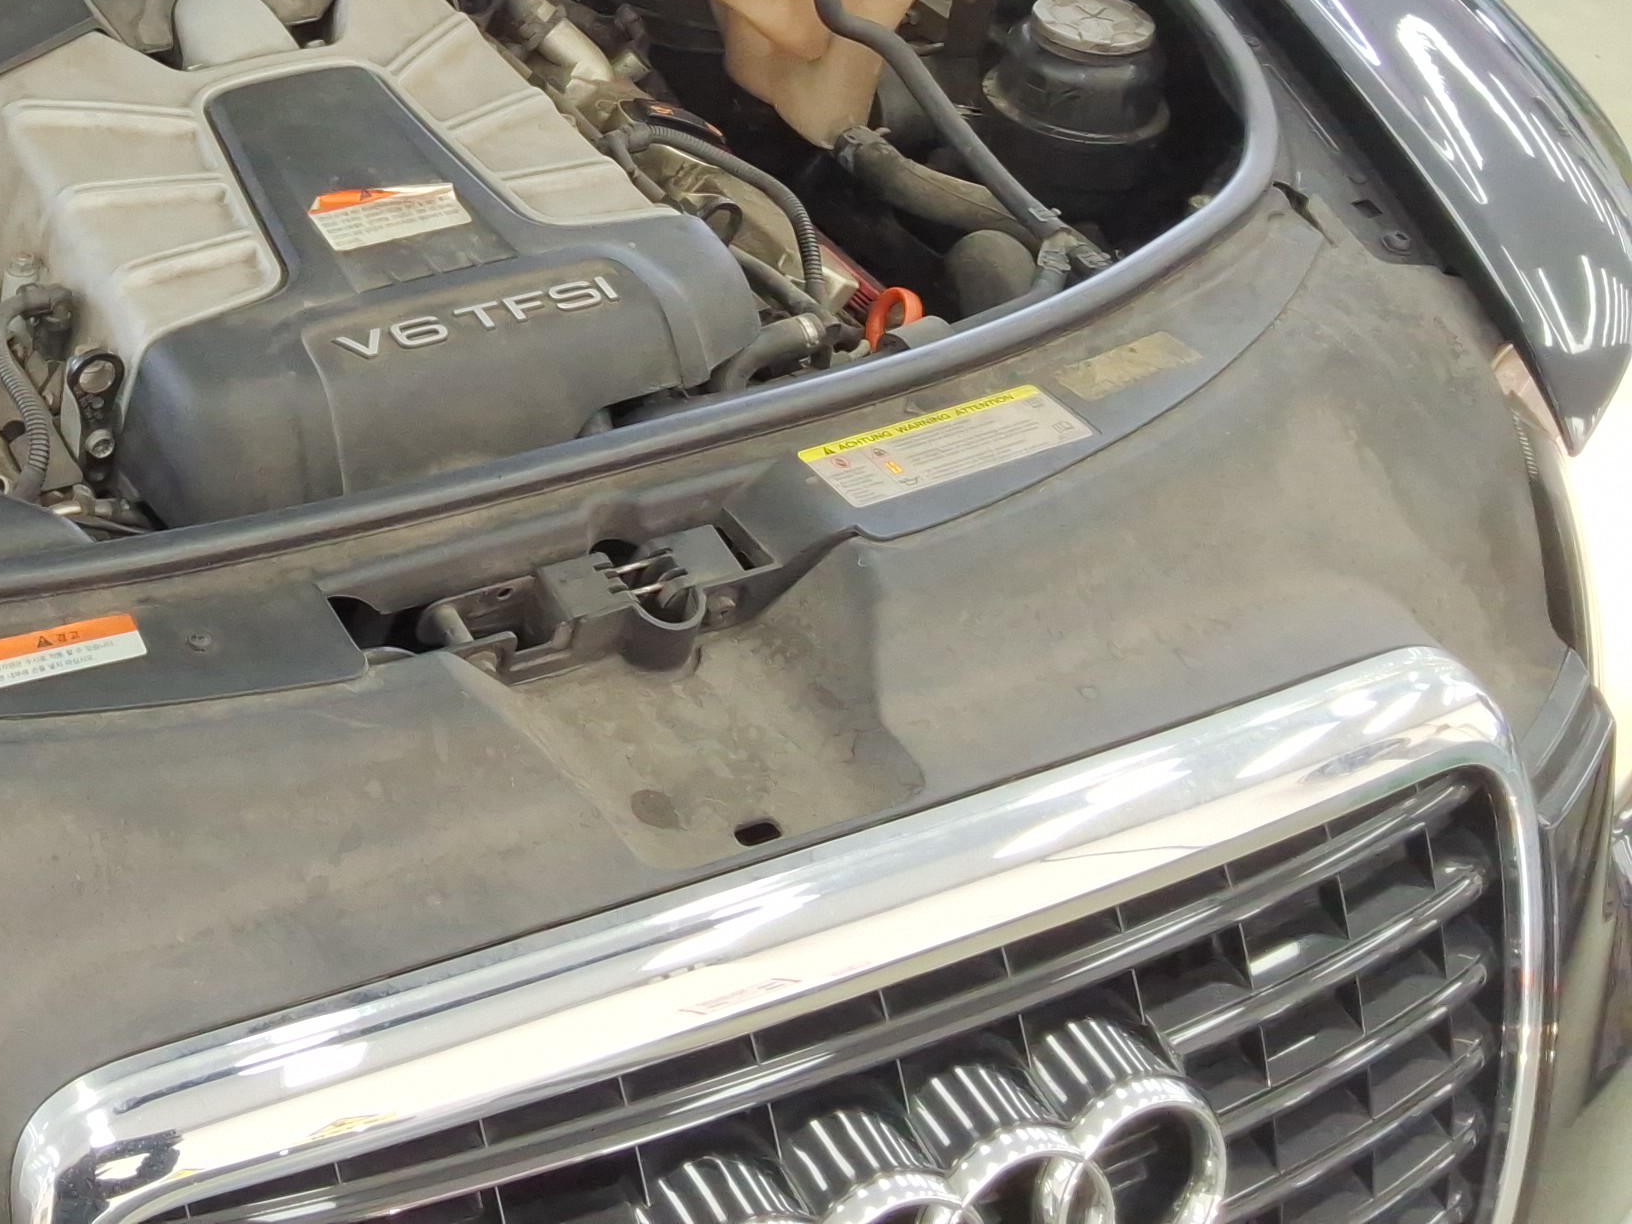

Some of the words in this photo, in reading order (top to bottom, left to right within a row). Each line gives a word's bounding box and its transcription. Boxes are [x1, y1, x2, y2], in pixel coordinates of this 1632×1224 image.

[331, 315, 449, 360] V6
[452, 275, 619, 331] TFSI
[837, 429, 894, 451] ACHTUNG
[895, 411, 953, 435] WARNING
[954, 391, 1016, 418] ATTENTION
